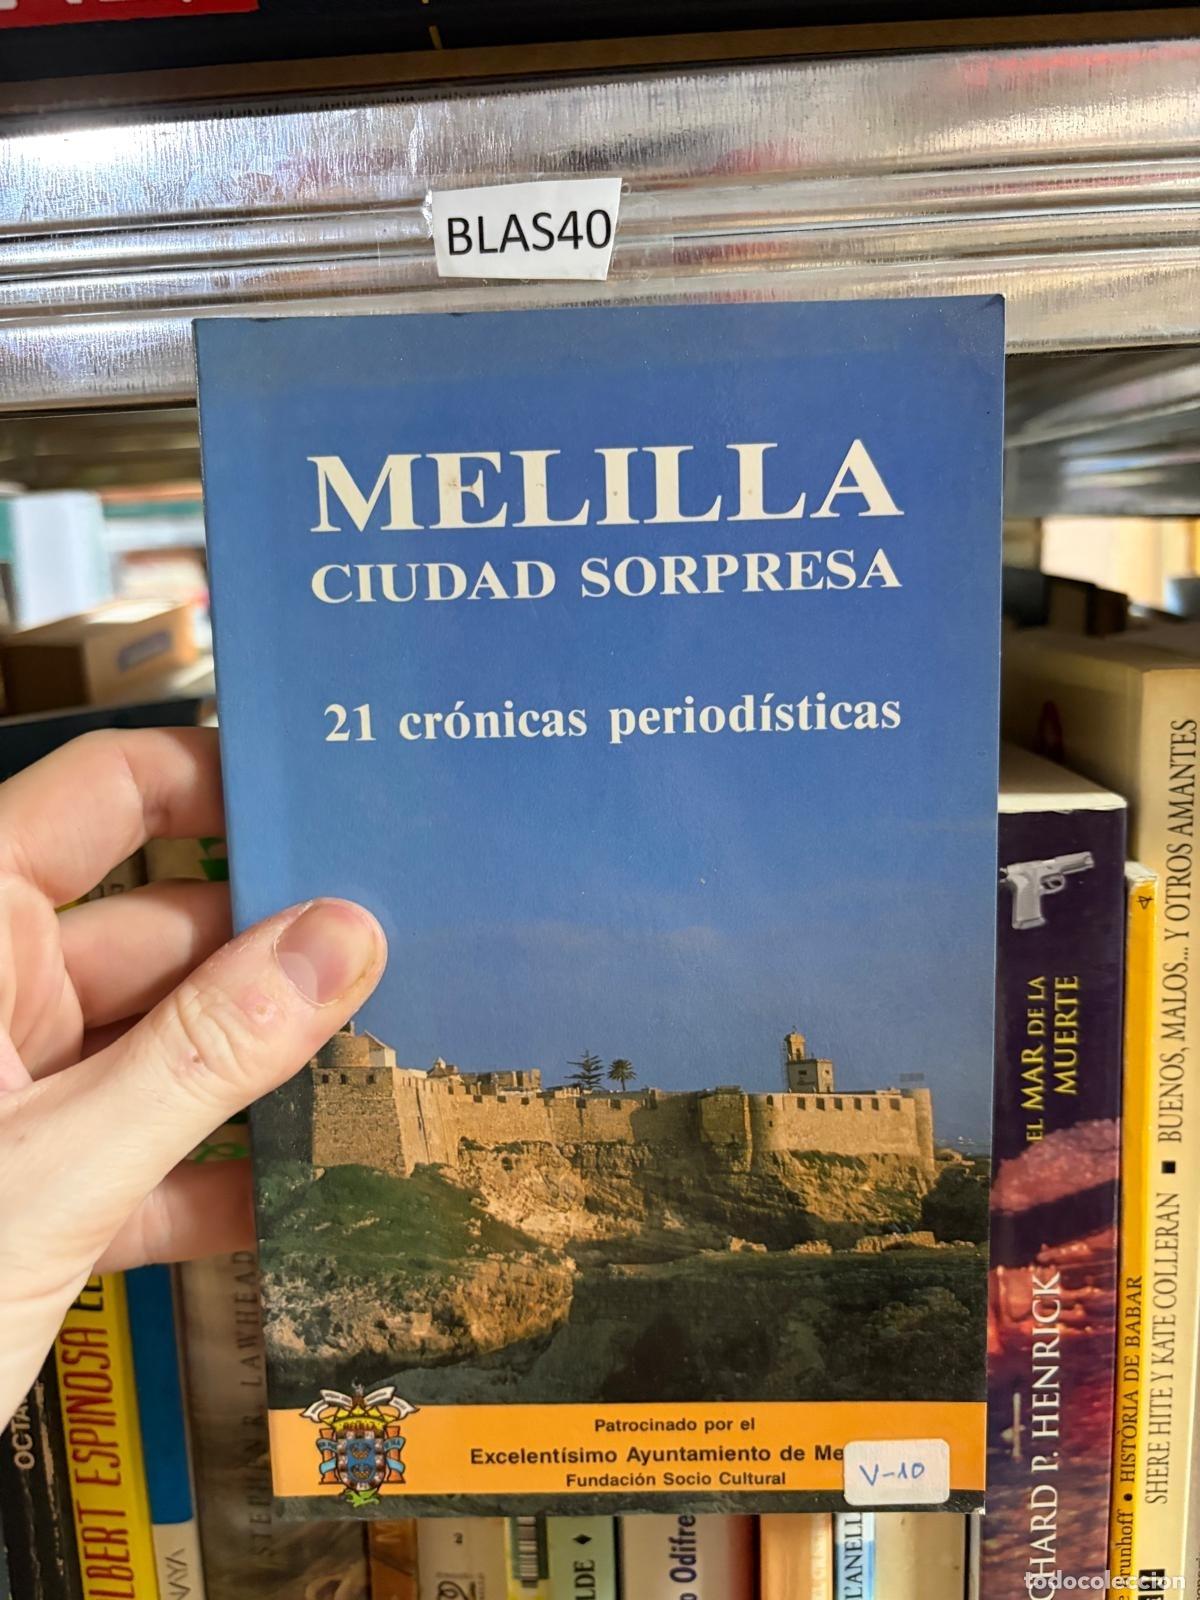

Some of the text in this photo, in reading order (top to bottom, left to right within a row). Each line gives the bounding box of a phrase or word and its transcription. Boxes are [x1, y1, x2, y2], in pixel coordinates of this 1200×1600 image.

[447, 209, 613, 256] BLAS40
[306, 438, 905, 534] MELILLA
[311, 548, 903, 604] CIUDAD SORPRESA
[324, 692, 902, 745] 21 crónicas periodísticas
[1167, 718, 1198, 837] AMANTES
[1164, 843, 1194, 922] OTROS
[1164, 927, 1190, 942] Y
[1021, 975, 1047, 1142] EL MAR DE LA
[1053, 975, 1080, 1096] MUERTE
[1158, 1047, 1191, 1143] BUENOS,
[1153, 1192, 1182, 1310] COLLERAN
[1126, 1276, 1143, 1348] BABAR
[1151, 1314, 1177, 1365] KATE
[1031, 1271, 1061, 1440] HENRICK
[1123, 1355, 1141, 1382] DE
[1151, 1373, 1174, 1386] Y
[11, 1398, 35, 1470] OCTA
[60, 1327, 122, 1487] ESPINOSA
[594, 1417, 756, 1434] Patrocinado por el
[1116, 1391, 1140, 1483] HISTÒRIA
[1148, 1387, 1174, 1436] HITE
[470, 1447, 618, 1465] Excelentísimo
[626, 1446, 771, 1466] Ayuntamiento
[780, 1445, 806, 1462] de
[566, 1471, 786, 1488] Fundación Socio Cultural
[859, 1462, 925, 1487] V-10
[1031, 1451, 1060, 1473] P.
[1145, 1441, 1171, 1504] SHERE
[1116, 1509, 1134, 1588] runhoff
